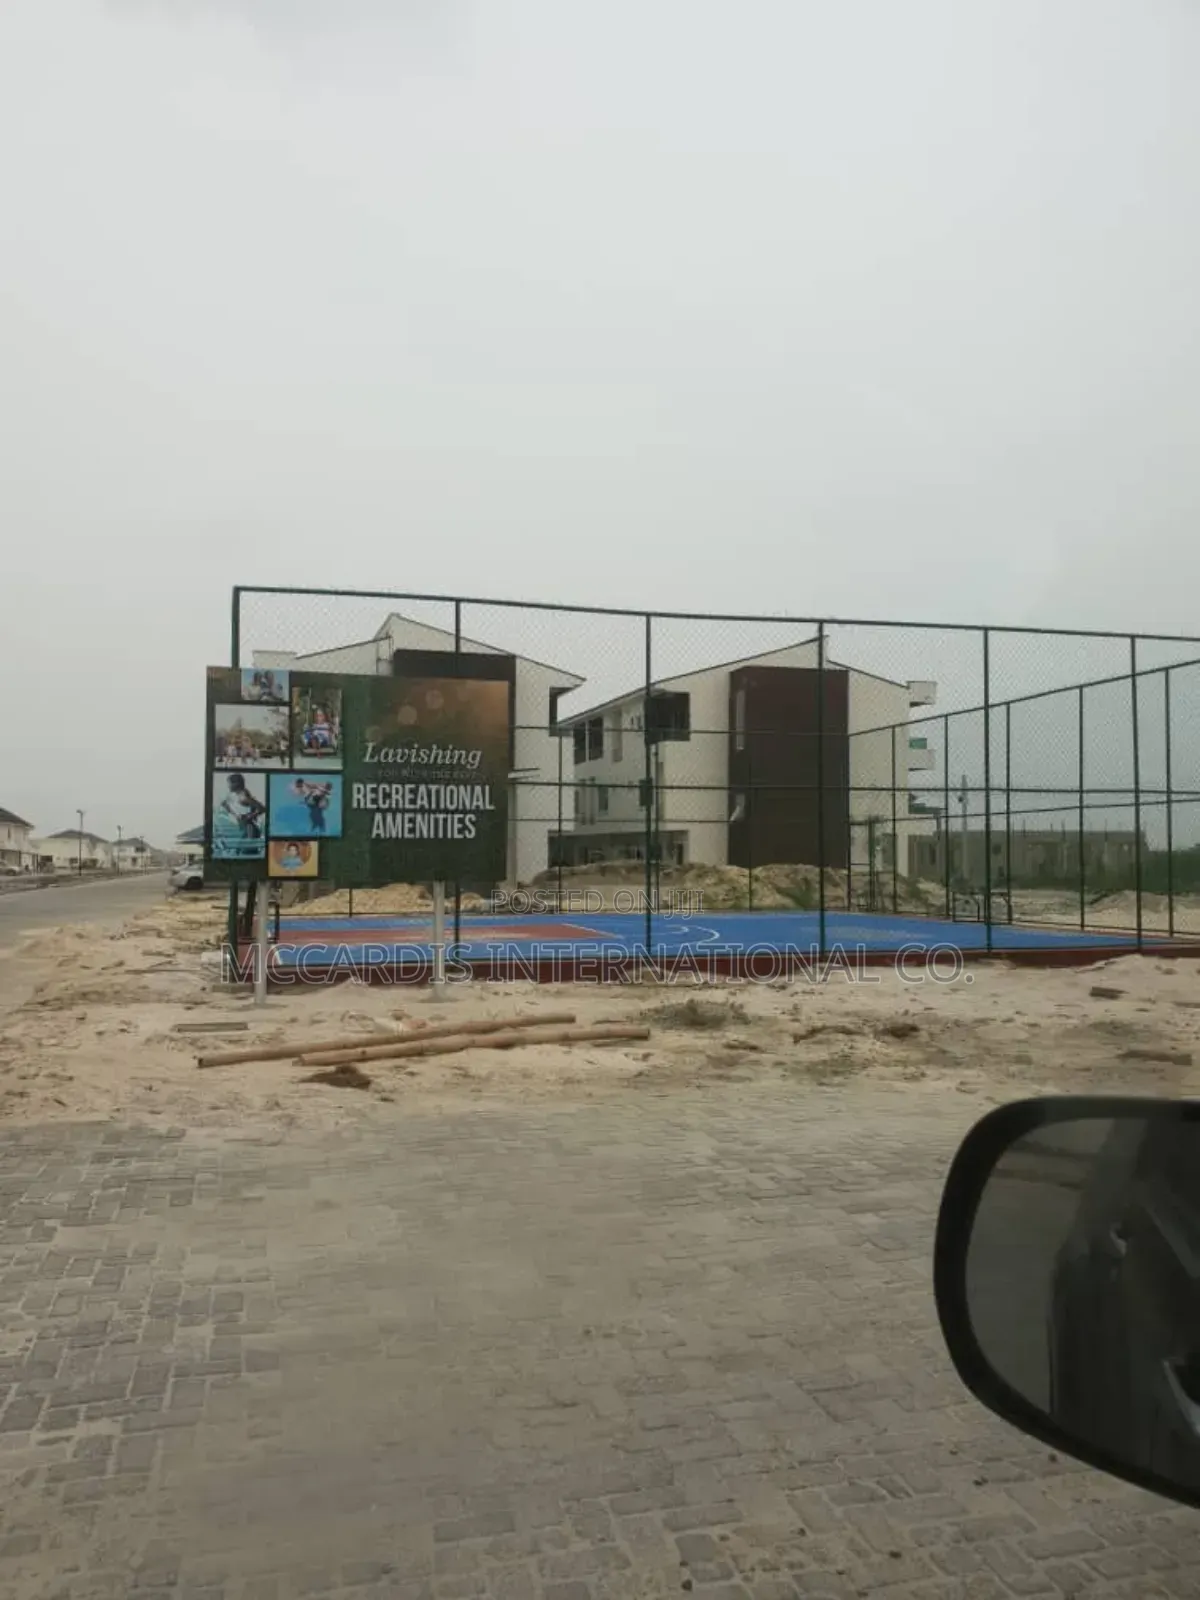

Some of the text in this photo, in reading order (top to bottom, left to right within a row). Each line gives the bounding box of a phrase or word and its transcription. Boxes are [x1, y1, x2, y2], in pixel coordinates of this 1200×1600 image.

[363, 741, 482, 769] Lavishing
[352, 783, 495, 811] RECREATIONAL
[371, 812, 476, 839] AMENITIES
